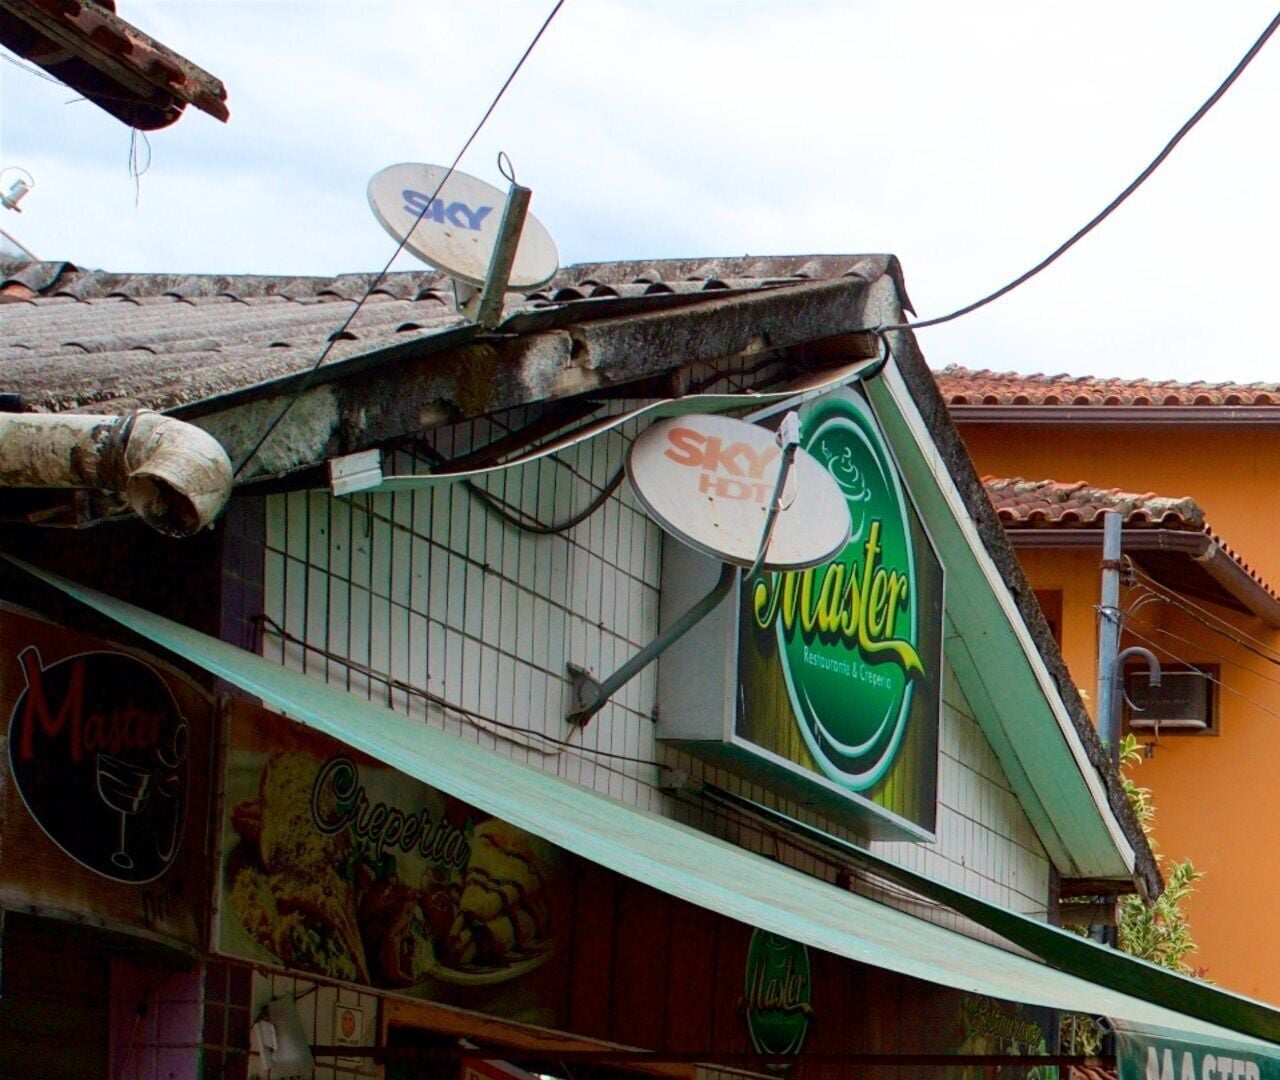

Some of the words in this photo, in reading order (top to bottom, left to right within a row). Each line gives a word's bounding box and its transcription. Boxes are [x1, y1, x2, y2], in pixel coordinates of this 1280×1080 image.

[402, 189, 494, 231] SKY
[664, 427, 780, 479] SKY
[754, 520, 926, 679] Master
[18, 645, 166, 763] Master
[310, 755, 471, 871] Creperia
[738, 954, 814, 1017] Master
